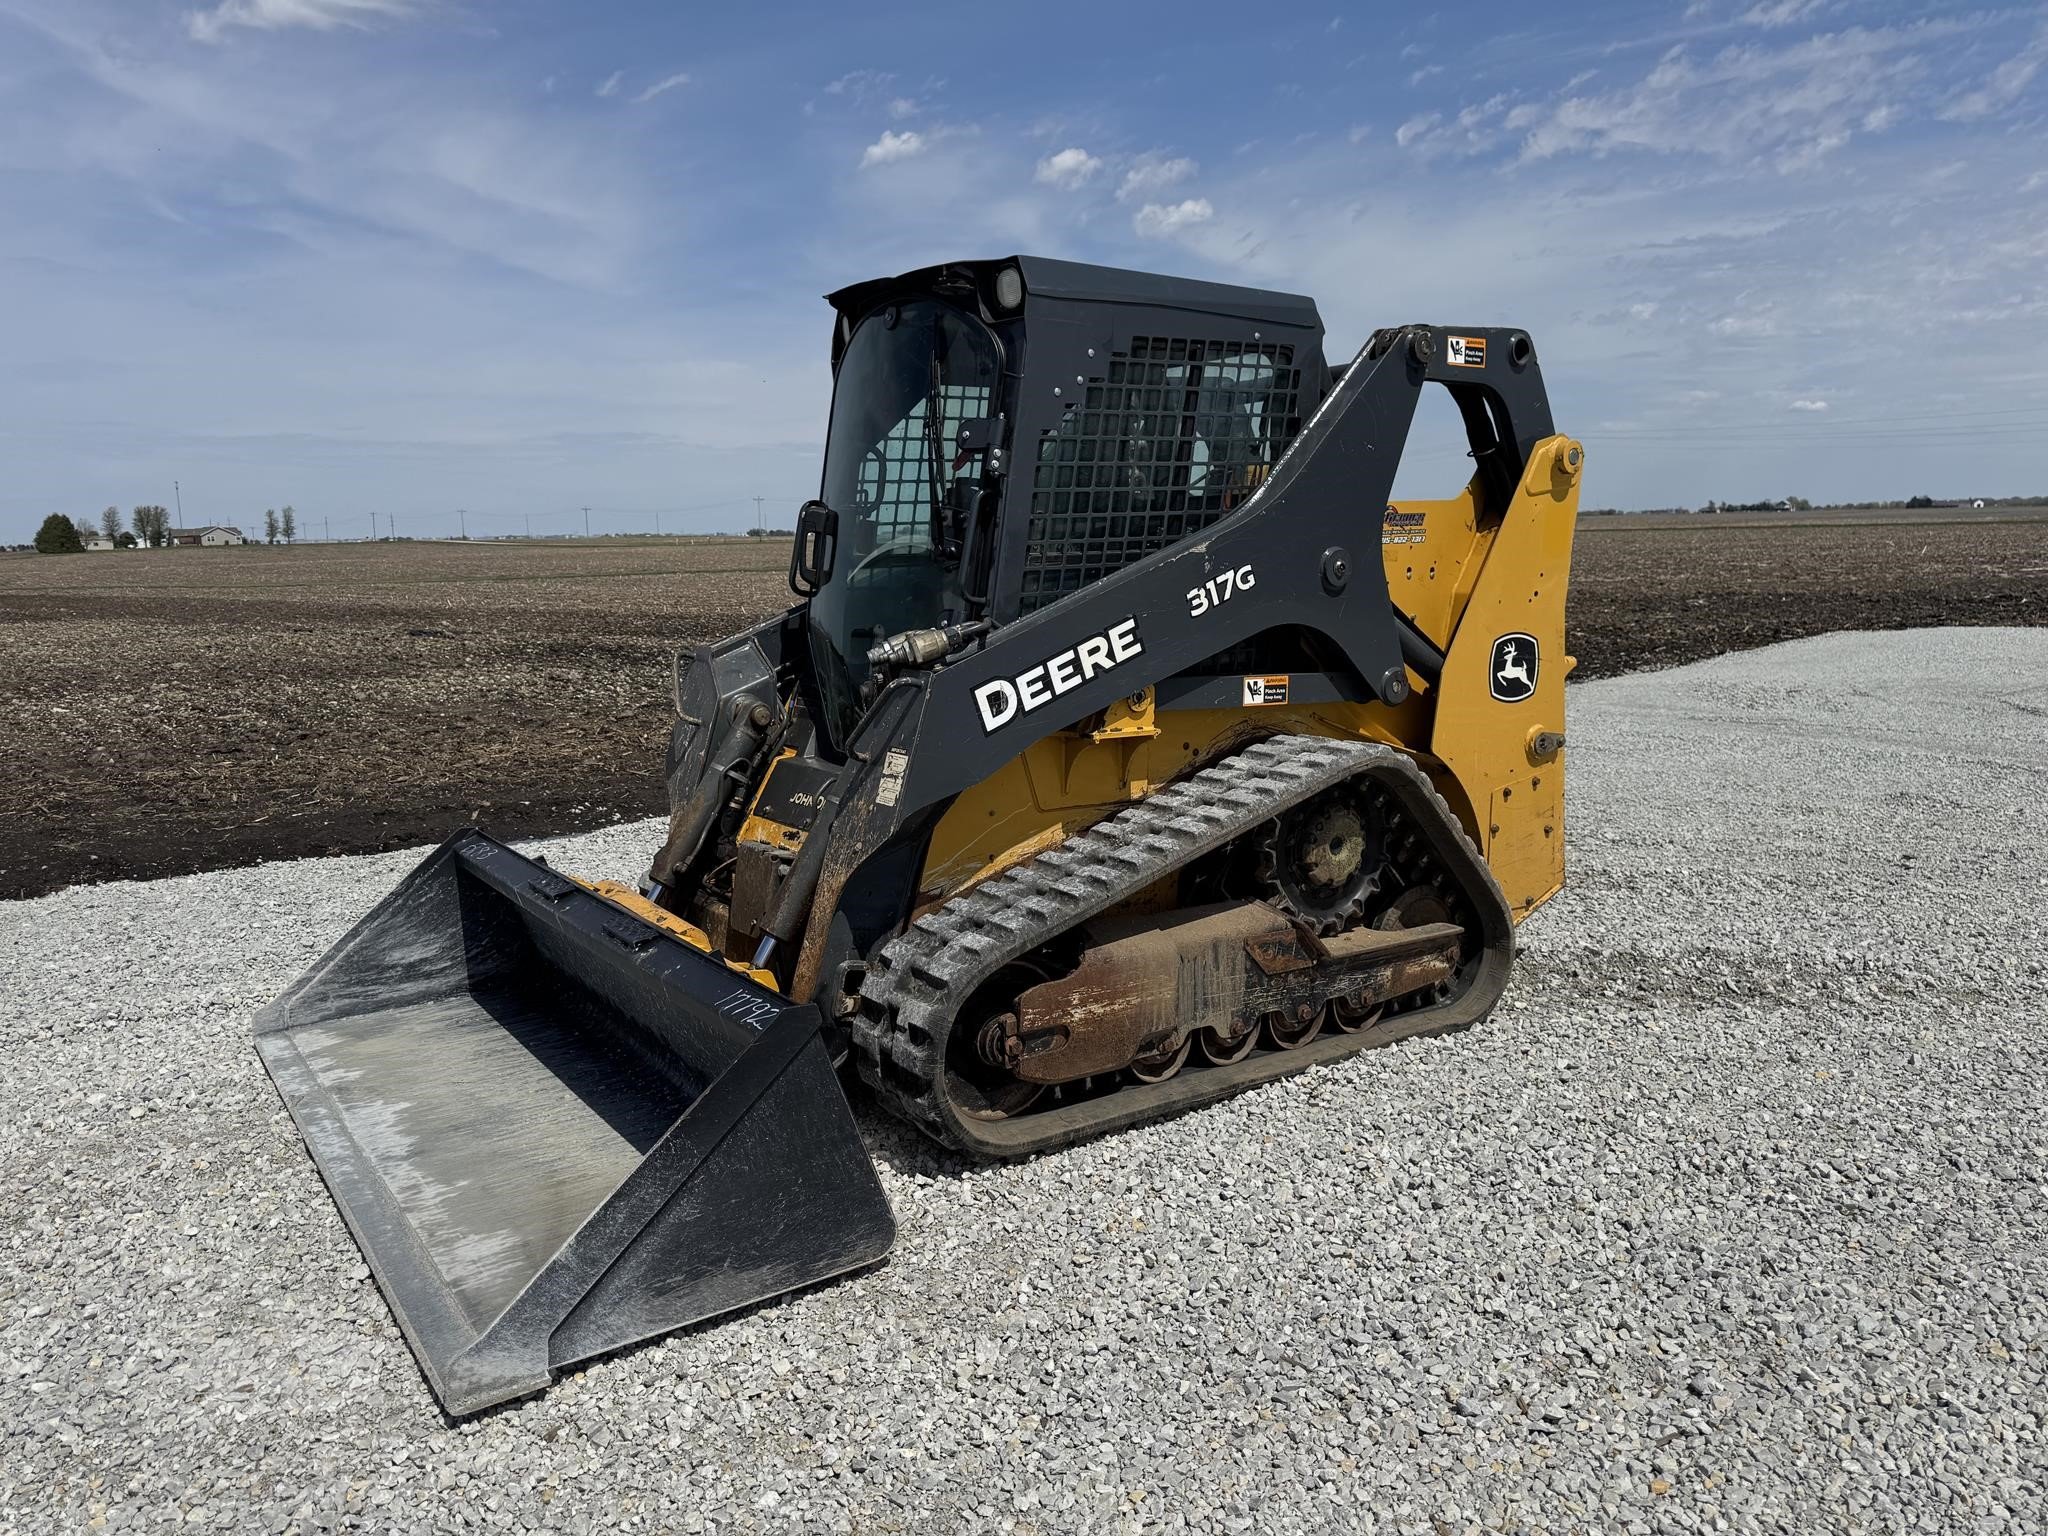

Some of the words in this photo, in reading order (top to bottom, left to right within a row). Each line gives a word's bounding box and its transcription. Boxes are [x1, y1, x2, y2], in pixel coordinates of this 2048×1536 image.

[1186, 564, 1256, 617] 317G
[974, 618, 1142, 732] DEERE
[714, 988, 780, 1030] 17792
